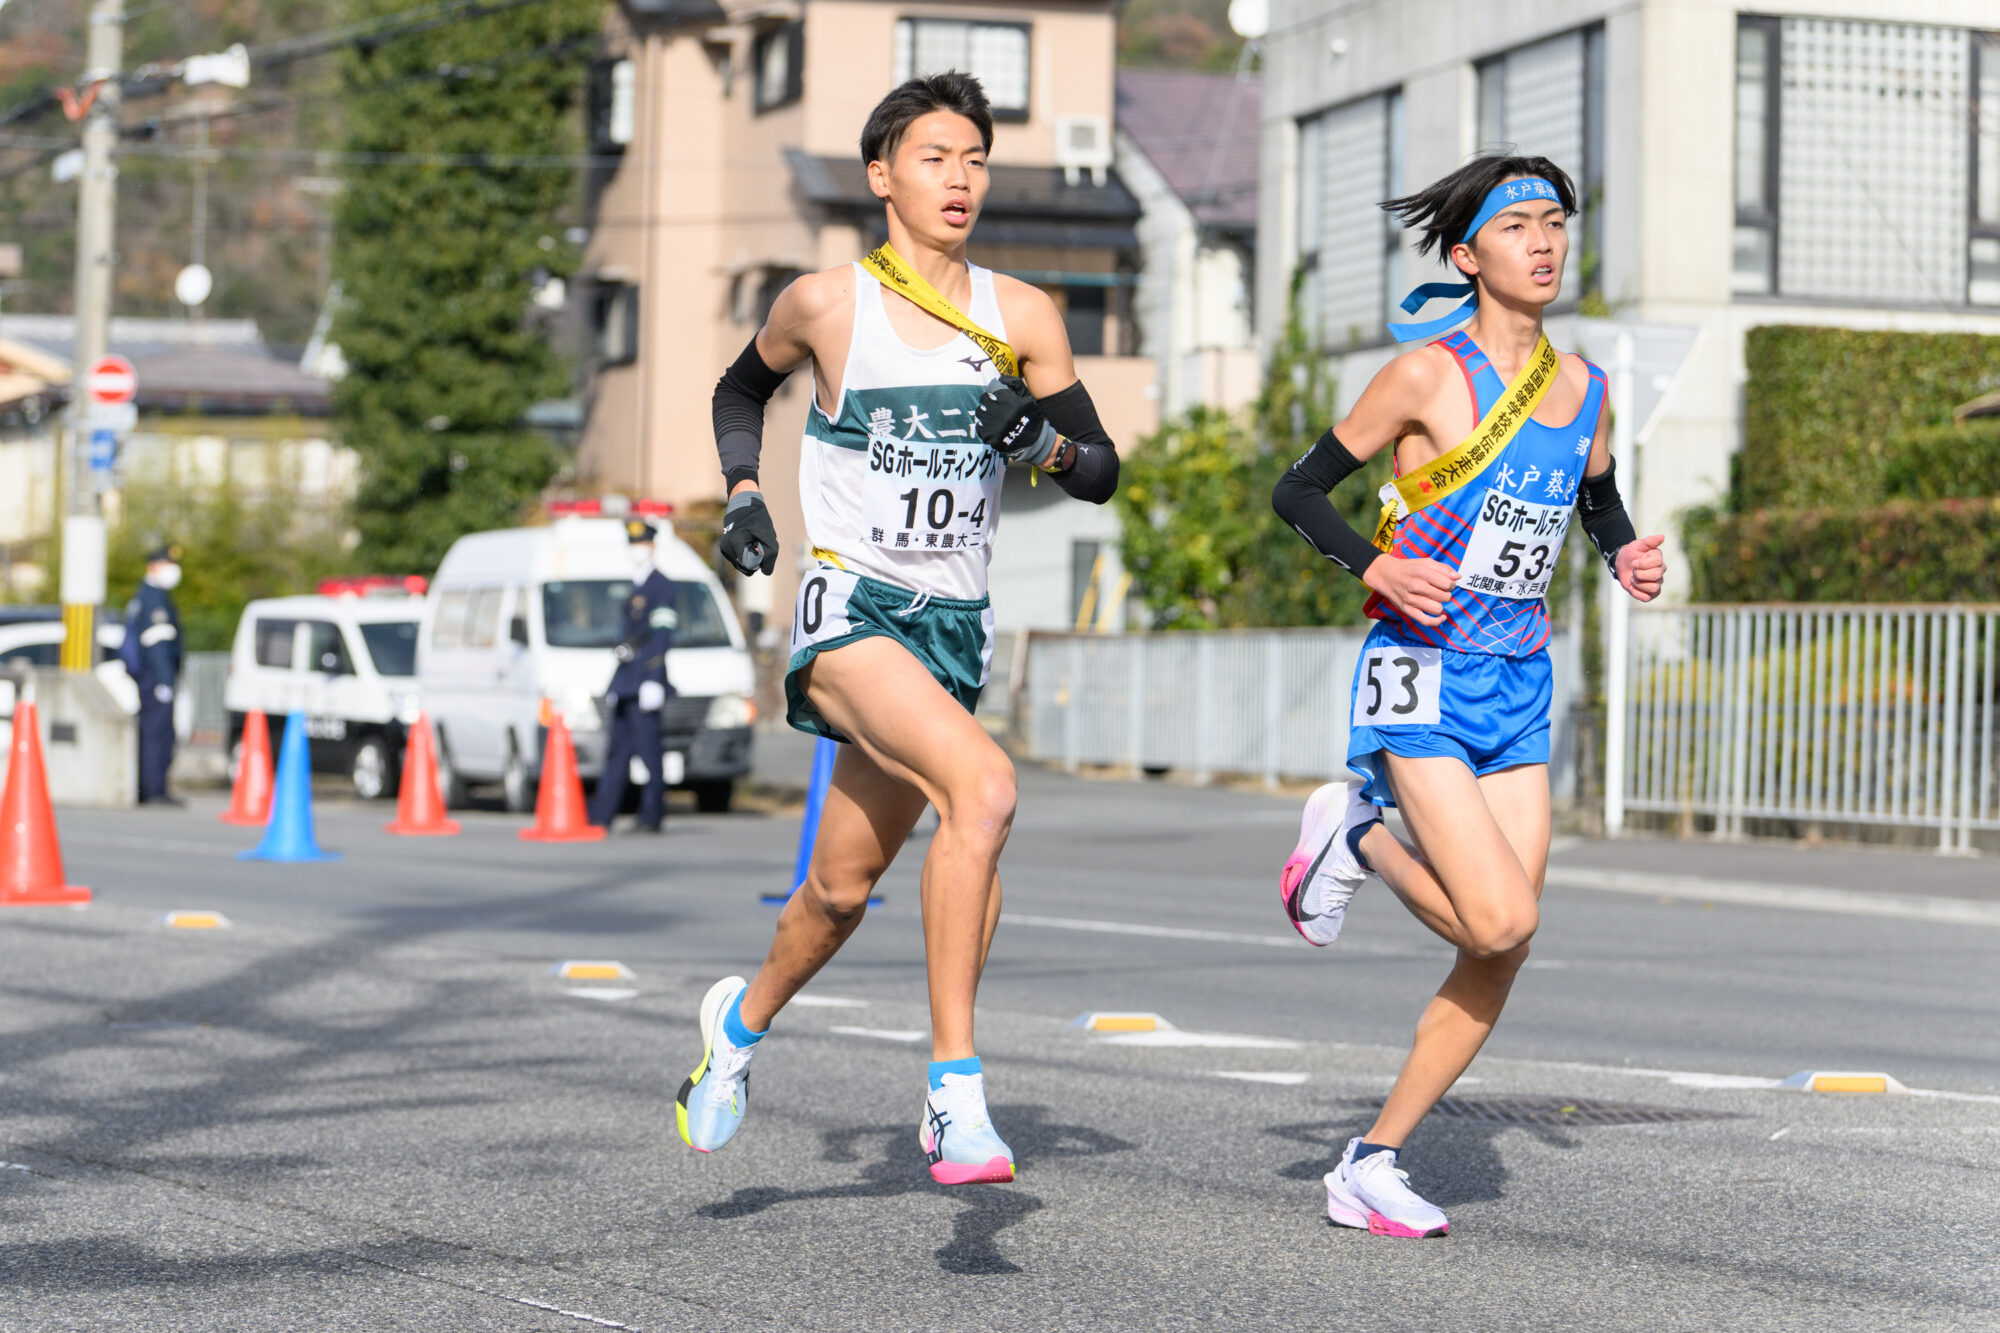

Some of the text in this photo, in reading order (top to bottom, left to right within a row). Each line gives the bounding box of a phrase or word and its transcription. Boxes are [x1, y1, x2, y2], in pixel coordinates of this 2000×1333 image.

[1430, 339, 1556, 490] 回全国高等学校駅伝競走大会
[900, 487, 986, 530] 10-4
[1494, 540, 1554, 581] 53-
[1366, 656, 1420, 716] 53
